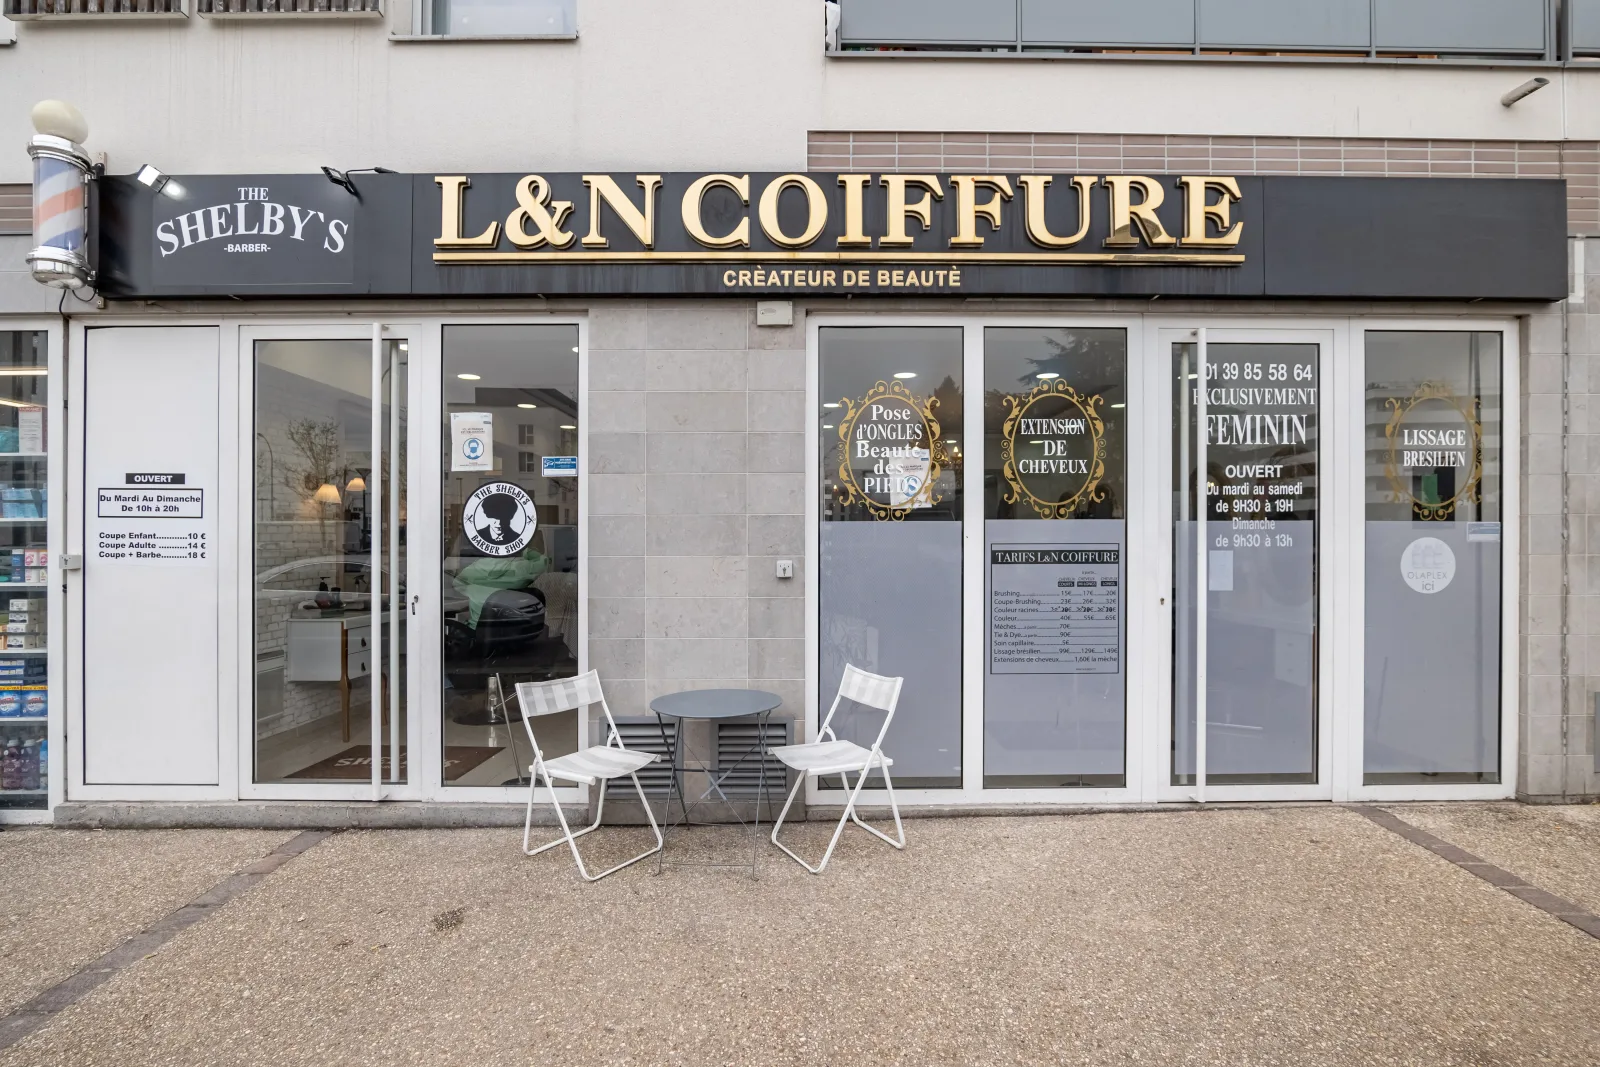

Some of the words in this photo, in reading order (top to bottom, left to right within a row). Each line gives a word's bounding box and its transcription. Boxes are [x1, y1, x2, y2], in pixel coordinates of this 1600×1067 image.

[237, 187, 269, 200] THE
[434, 174, 663, 249] L&N
[681, 174, 1244, 249] COIFFURE
[842, 270, 870, 287] DE
[1222, 363, 1239, 380] 39
[1243, 363, 1262, 381] 85
[1268, 363, 1287, 381] 58
[1293, 364, 1313, 381] 64
[871, 404, 911, 421] Pose
[856, 424, 923, 440] d'ONGLES
[1020, 418, 1085, 435] EXTENSION
[1206, 414, 1307, 445] FEMININ
[1403, 429, 1466, 446] LISSAGE
[856, 441, 921, 459] Beauté
[1043, 440, 1067, 456] DE
[1018, 459, 1088, 474] CHEVEUX
[1403, 451, 1466, 467] BRESILIEN
[873, 459, 904, 475] des
[1225, 465, 1284, 478] OUVERT
[133, 475, 173, 483] OUVERT
[474, 486, 493, 501] THE
[1206, 481, 1219, 496] Du
[1222, 482, 1249, 496] mardi
[1253, 484, 1265, 496] au
[1268, 481, 1303, 496] samedi
[156, 495, 201, 503] Dimanche
[1215, 500, 1229, 513] de
[1232, 499, 1261, 513] 9H30
[1264, 499, 1271, 513] à
[1274, 499, 1294, 513] 19H
[1232, 517, 1276, 530] Dimanche
[99, 532, 126, 541] Coupe
[1215, 534, 1229, 547] de
[1233, 534, 1261, 547] 9h30
[1264, 534, 1271, 547] à
[1274, 534, 1293, 547] 13h
[99, 542, 126, 550] Coupe
[471, 534, 500, 555] BARBER
[505, 537, 525, 554] SHOP
[98, 551, 126, 560] Coupe
[996, 552, 1035, 563] TARIFS
[1037, 552, 1059, 563] L&N
[1060, 552, 1119, 563] COIFFURE
[1407, 571, 1448, 580] OLAPLEX
[994, 590, 1020, 598] Brushing
[1010, 631, 1021, 640] Dye
[1008, 640, 1034, 648] capillaire
